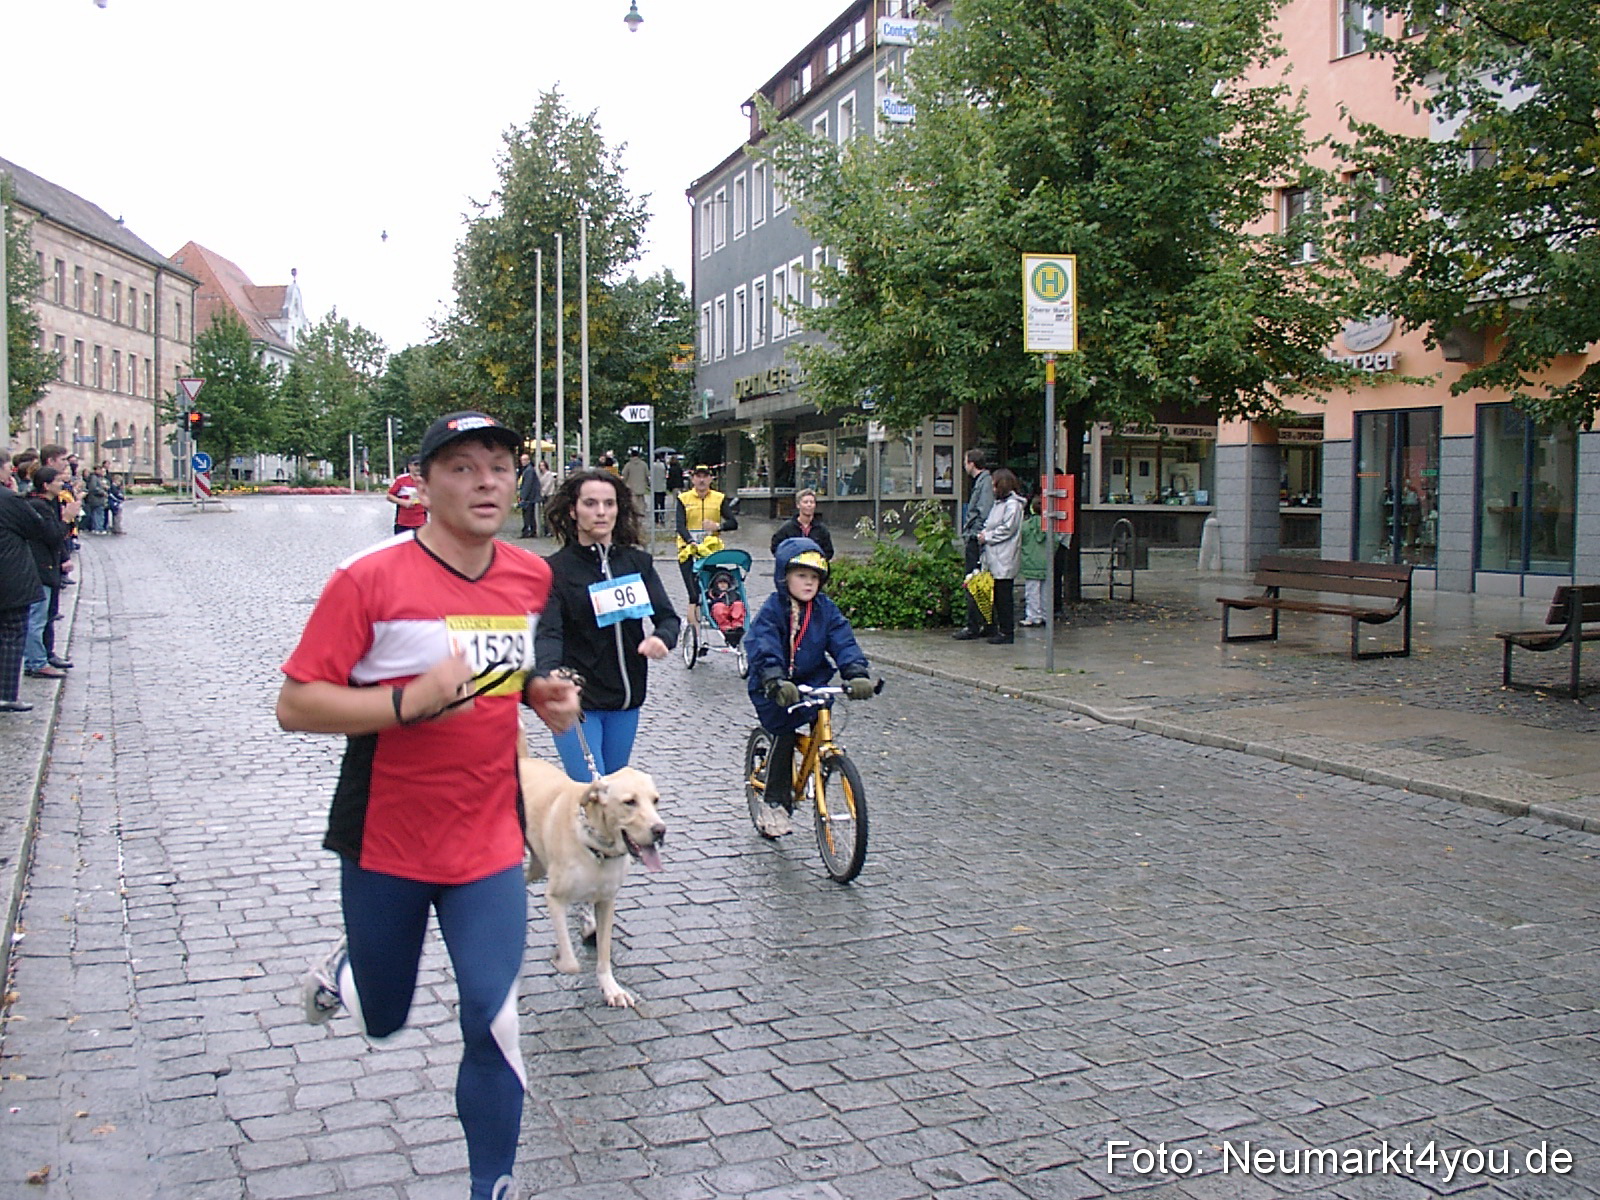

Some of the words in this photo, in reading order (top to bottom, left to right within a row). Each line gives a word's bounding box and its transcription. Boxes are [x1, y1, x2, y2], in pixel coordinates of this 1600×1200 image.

[1041, 271, 1059, 293] H
[629, 407, 647, 420] WC
[614, 585, 637, 608] 96
[470, 632, 525, 667] 1529
